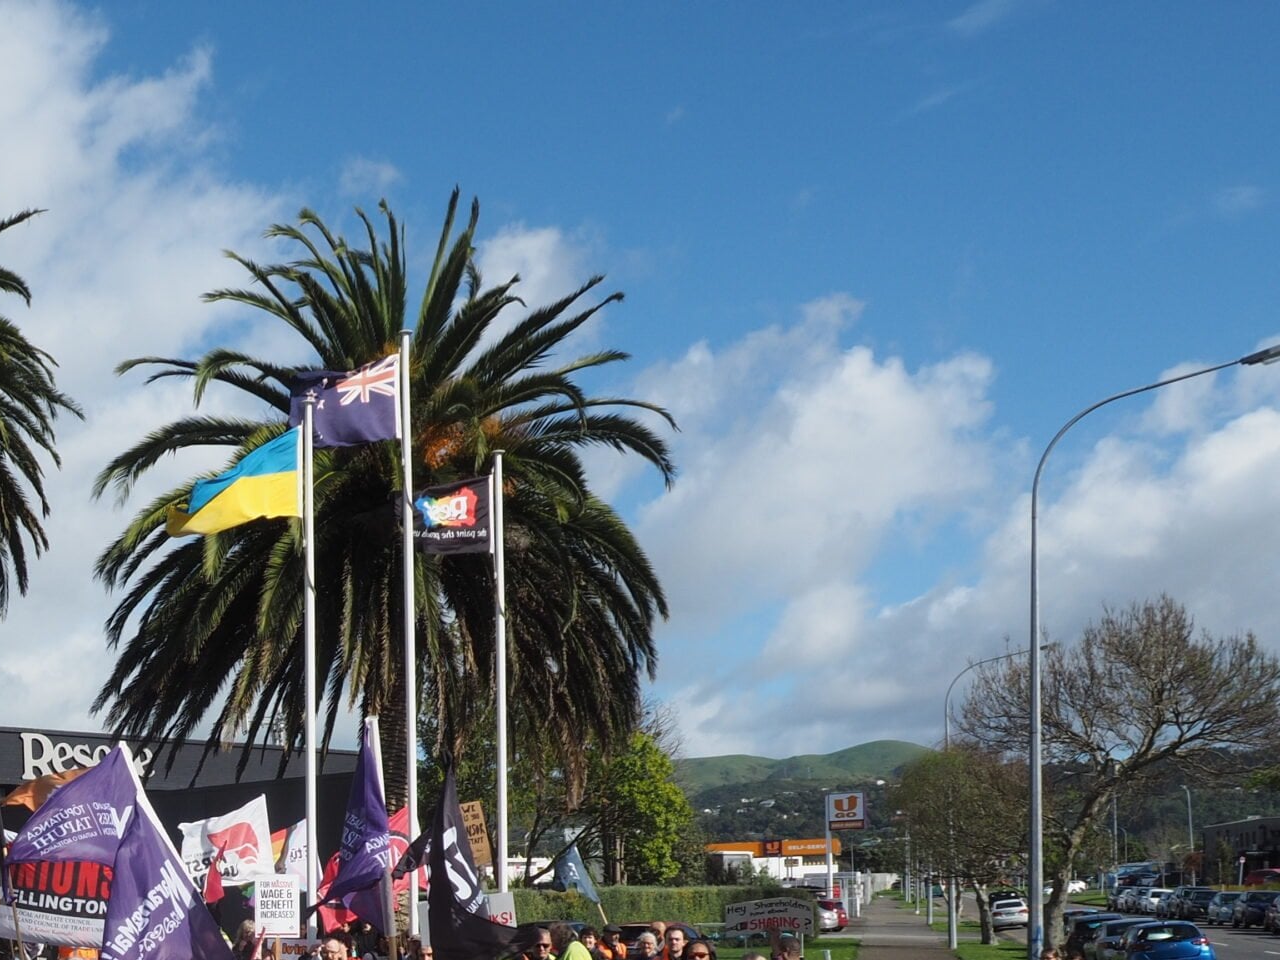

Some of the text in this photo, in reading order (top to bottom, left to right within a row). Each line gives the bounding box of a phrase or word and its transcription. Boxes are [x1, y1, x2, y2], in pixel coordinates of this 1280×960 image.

[21, 733, 155, 780] Rese
[10, 861, 113, 899] NIONS
[12, 888, 107, 915] ELLINGTON
[260, 889, 284, 899] WAGE
[260, 900, 293, 909] BENEFIT
[749, 916, 800, 930] SHARING
